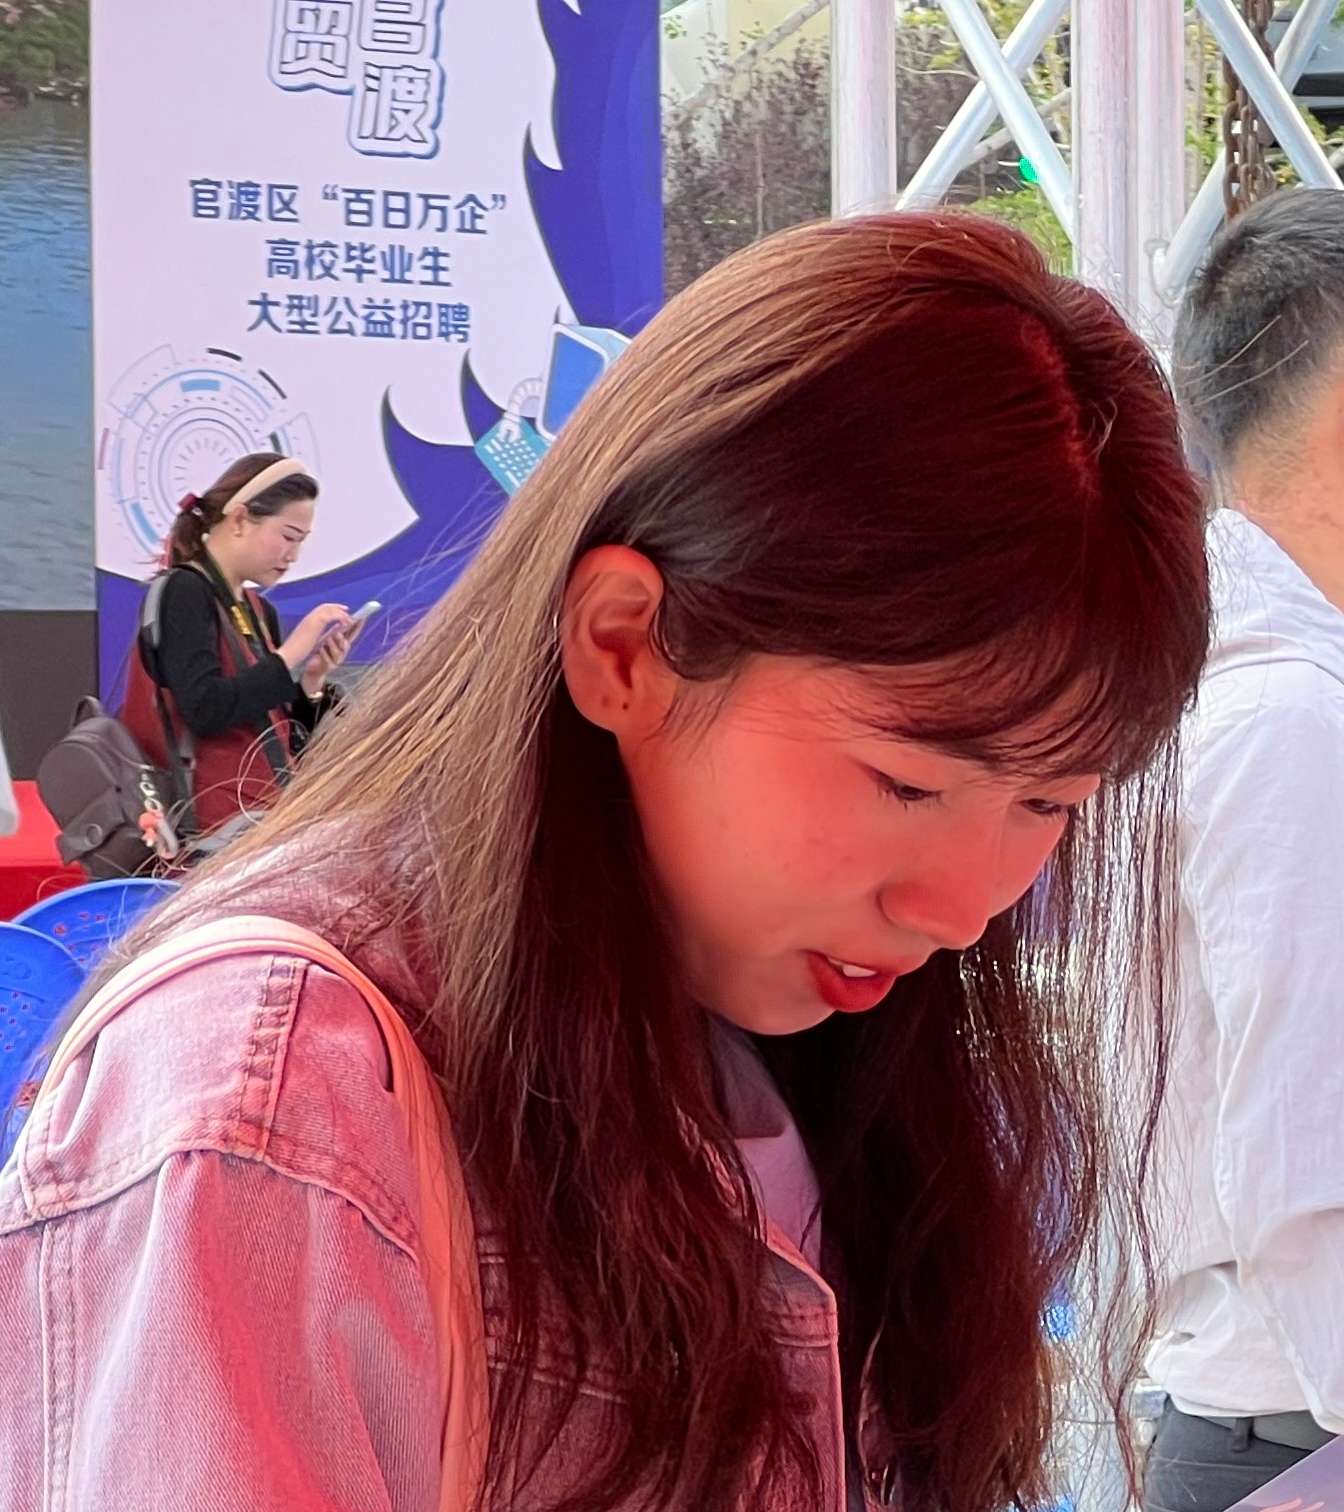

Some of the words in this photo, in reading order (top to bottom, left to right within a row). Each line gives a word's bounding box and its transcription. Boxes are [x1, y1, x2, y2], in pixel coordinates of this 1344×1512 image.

[265, 237, 453, 288] 高校毕业生
[246, 292, 472, 344] 大型公益招聘
